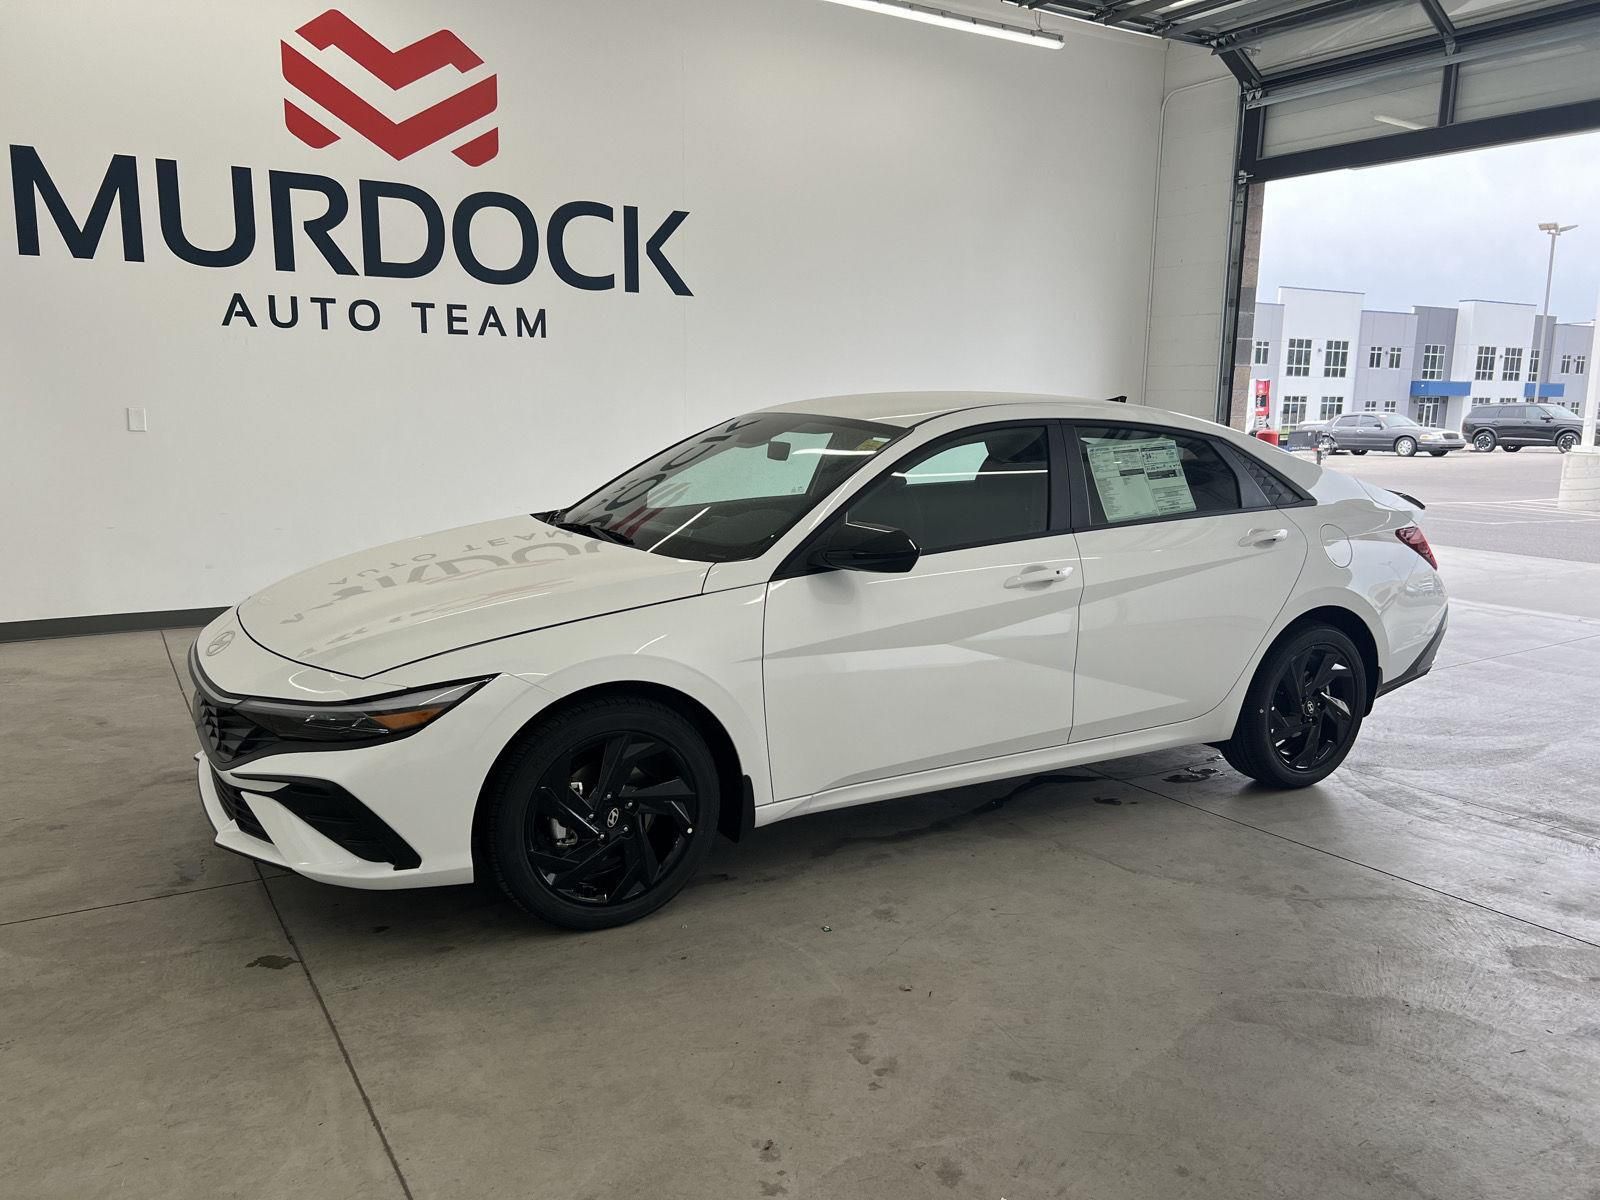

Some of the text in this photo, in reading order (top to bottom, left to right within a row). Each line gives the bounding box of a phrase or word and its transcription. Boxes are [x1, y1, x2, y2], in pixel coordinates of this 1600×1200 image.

[10, 144, 694, 297] MURDOCK
[222, 293, 547, 339] AUTO TEAM
